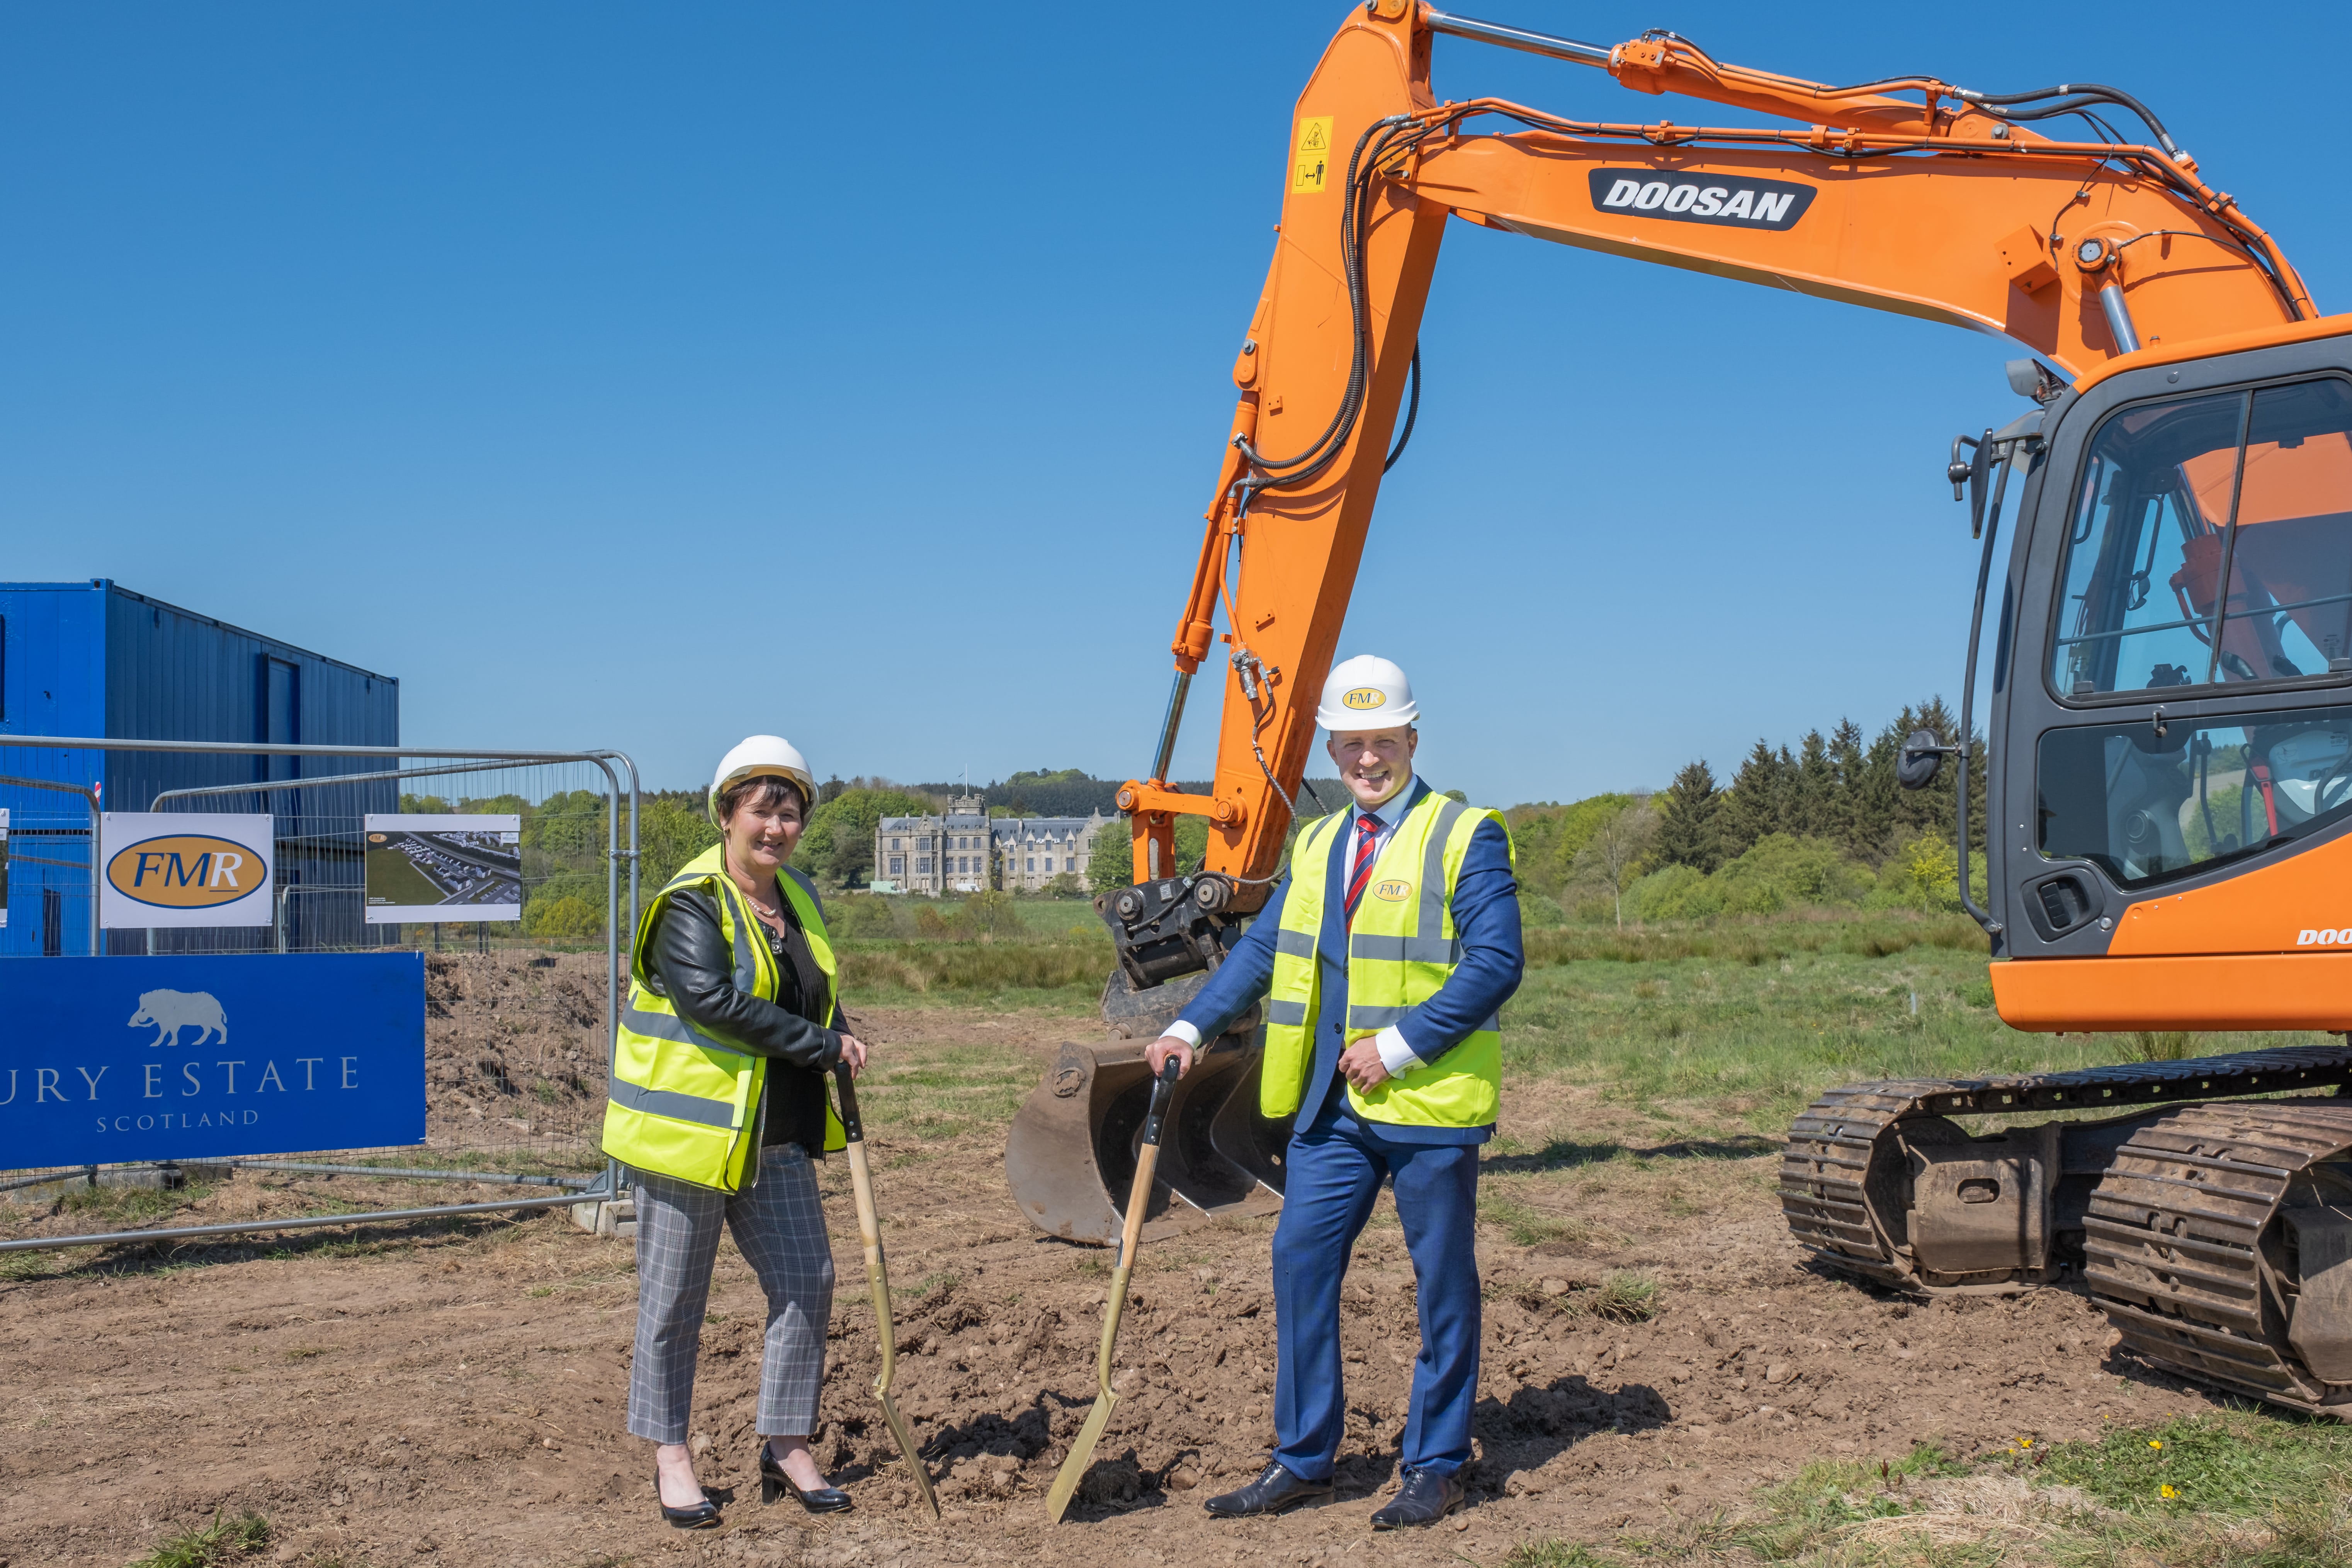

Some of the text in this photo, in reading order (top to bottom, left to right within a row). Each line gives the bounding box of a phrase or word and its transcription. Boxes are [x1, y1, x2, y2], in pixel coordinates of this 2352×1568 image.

[1602, 179, 1795, 222] DOOSAN
[1349, 692, 1380, 704] FMR
[134, 853, 243, 887] FMR
[1379, 884, 1409, 896] FMR
[142, 1056, 359, 1098] ESTATE
[97, 1110, 258, 1132] SCOTLAND
